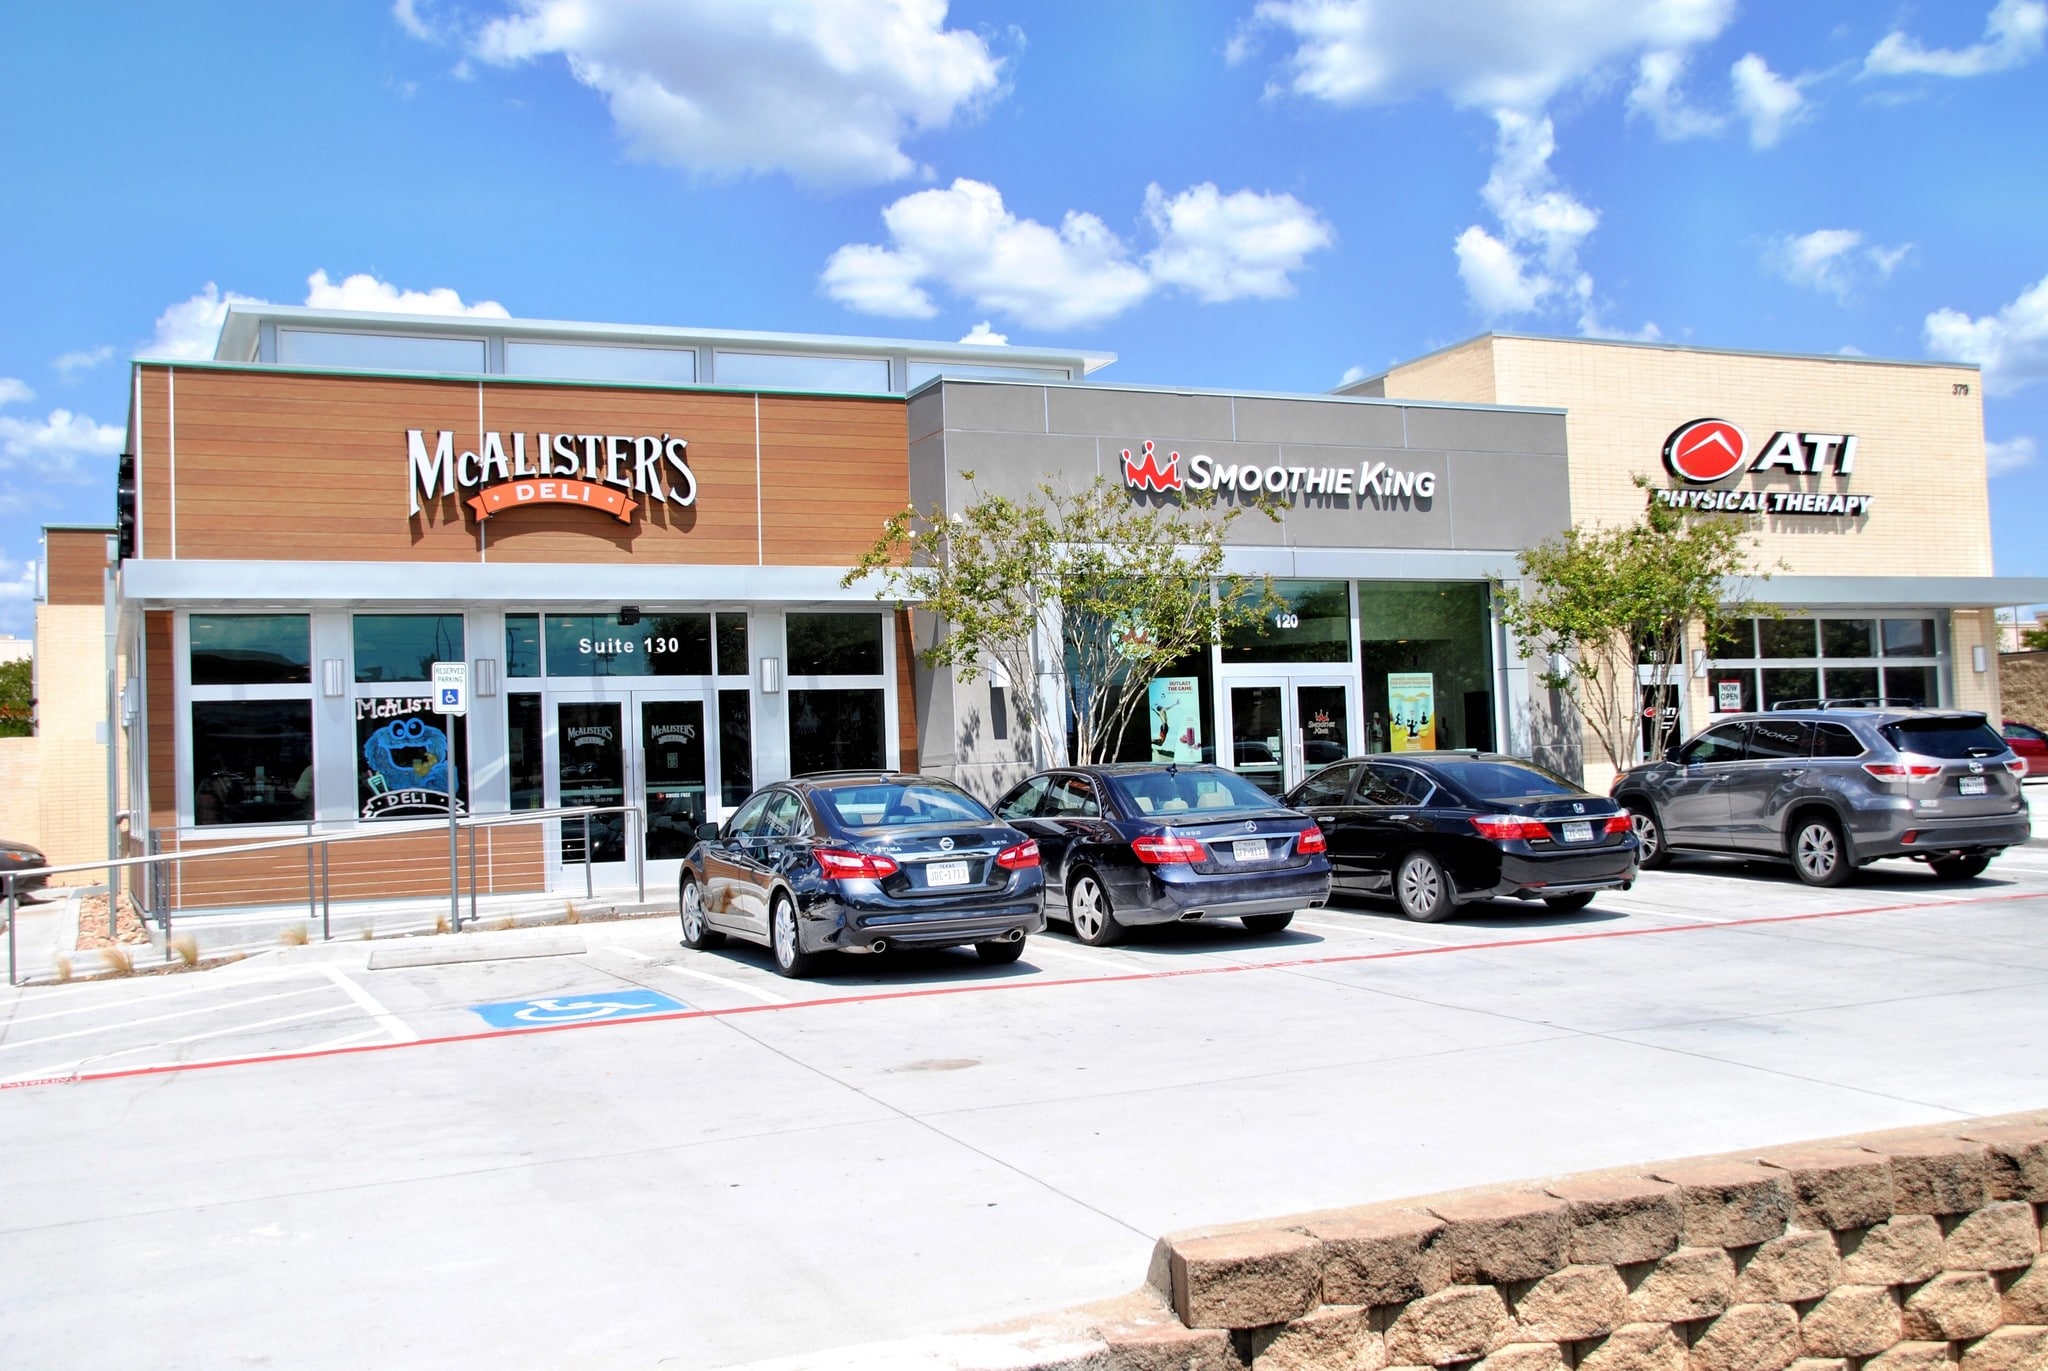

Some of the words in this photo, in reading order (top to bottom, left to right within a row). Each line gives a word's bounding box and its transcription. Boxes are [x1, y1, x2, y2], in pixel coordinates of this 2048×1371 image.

[1951, 383, 1969, 396] 379
[1750, 431, 1859, 475] ATI
[1185, 454, 1354, 494] SMOOTHIE
[515, 482, 590, 502] DELI
[1772, 494, 1874, 513] THERAPY
[1275, 614, 1299, 628] 120
[579, 637, 634, 654] Suite
[644, 637, 679, 653] 130
[435, 667, 465, 675] RESERVED
[1721, 684, 1738, 692] NOW
[356, 698, 434, 720] McALIST
[387, 792, 427, 806] DELI
